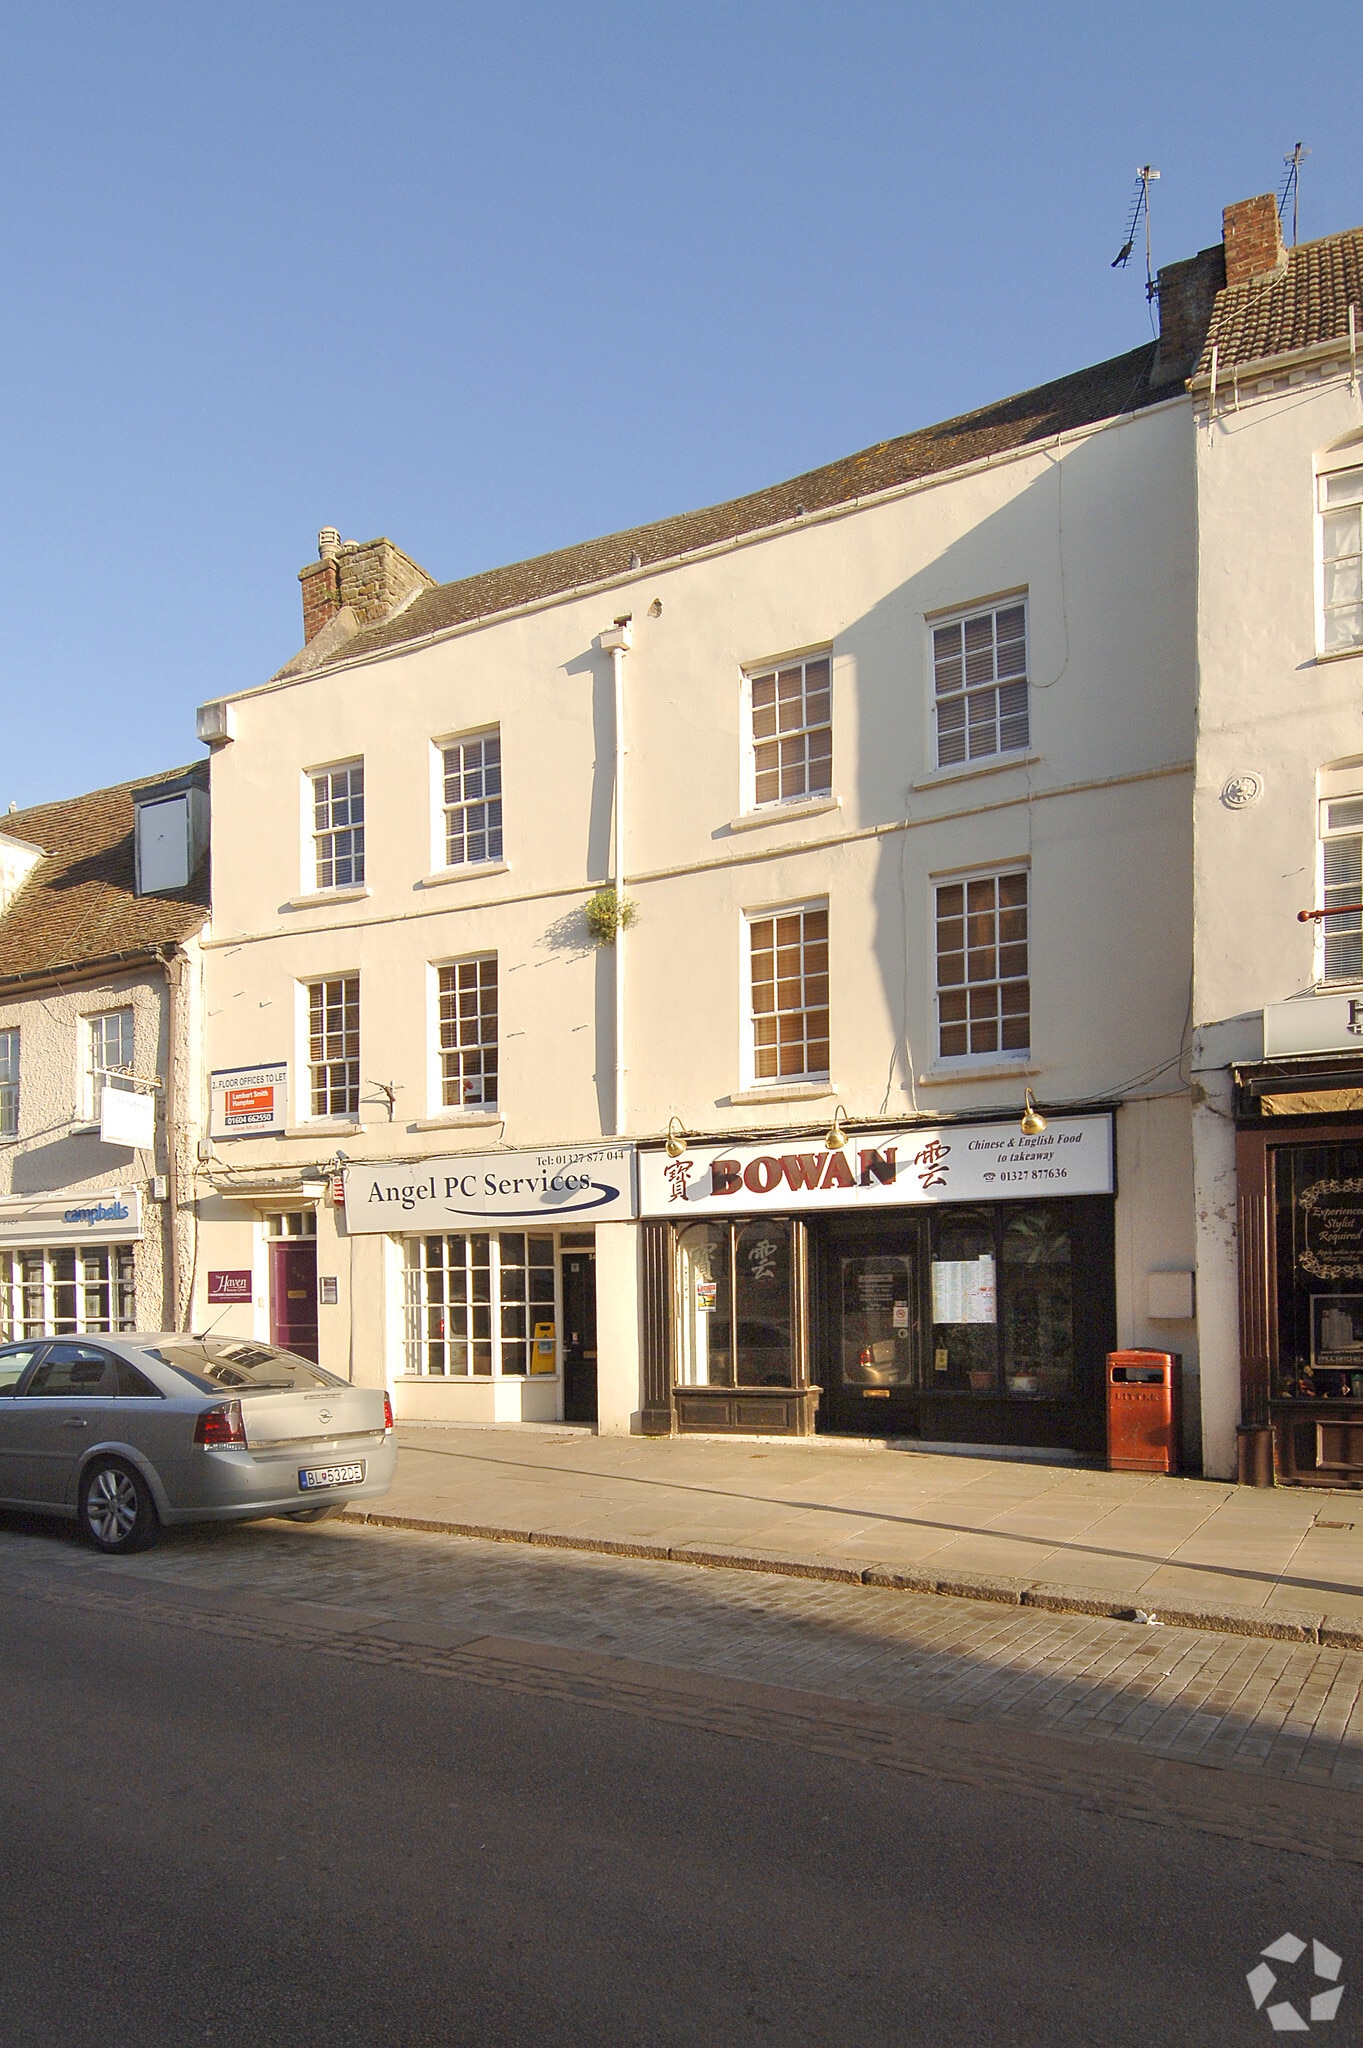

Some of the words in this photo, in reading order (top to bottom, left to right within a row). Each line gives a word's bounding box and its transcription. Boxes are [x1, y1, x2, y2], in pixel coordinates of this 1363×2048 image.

[219, 1079, 239, 1088] FLOOR
[240, 1075, 264, 1086] OFFICES
[266, 1074, 274, 1083] TO
[275, 1072, 286, 1081] LET
[232, 1092, 253, 1100] Lambert
[228, 1116, 247, 1125] 01604
[248, 1113, 272, 1123] 662550
[967, 1139, 1005, 1151] Chinese
[1007, 1138, 1015, 1147] &
[1018, 1134, 1054, 1149] English
[1057, 1132, 1082, 1144] Food
[535, 1155, 553, 1167] Tel:
[555, 1152, 584, 1165] 01327
[587, 1151, 604, 1163] 877
[997, 1154, 1007, 1163] to
[1009, 1151, 1055, 1164] takeaway
[709, 1147, 899, 1197] BOWAN
[1000, 1170, 1028, 1182] 01327
[1031, 1168, 1068, 1180] 877636
[367, 1176, 436, 1210] Angel
[444, 1174, 478, 1199] PC
[484, 1168, 591, 1196] Services
[64, 1201, 129, 1225] campbells
[1325, 1216, 1355, 1232] Stylist
[1319, 1229, 1363, 1245] Required
[213, 1275, 247, 1293] Haven
[1115, 1392, 1159, 1401] LITTER
[307, 1472, 322, 1485] BL
[327, 1466, 361, 1482] 532DE
